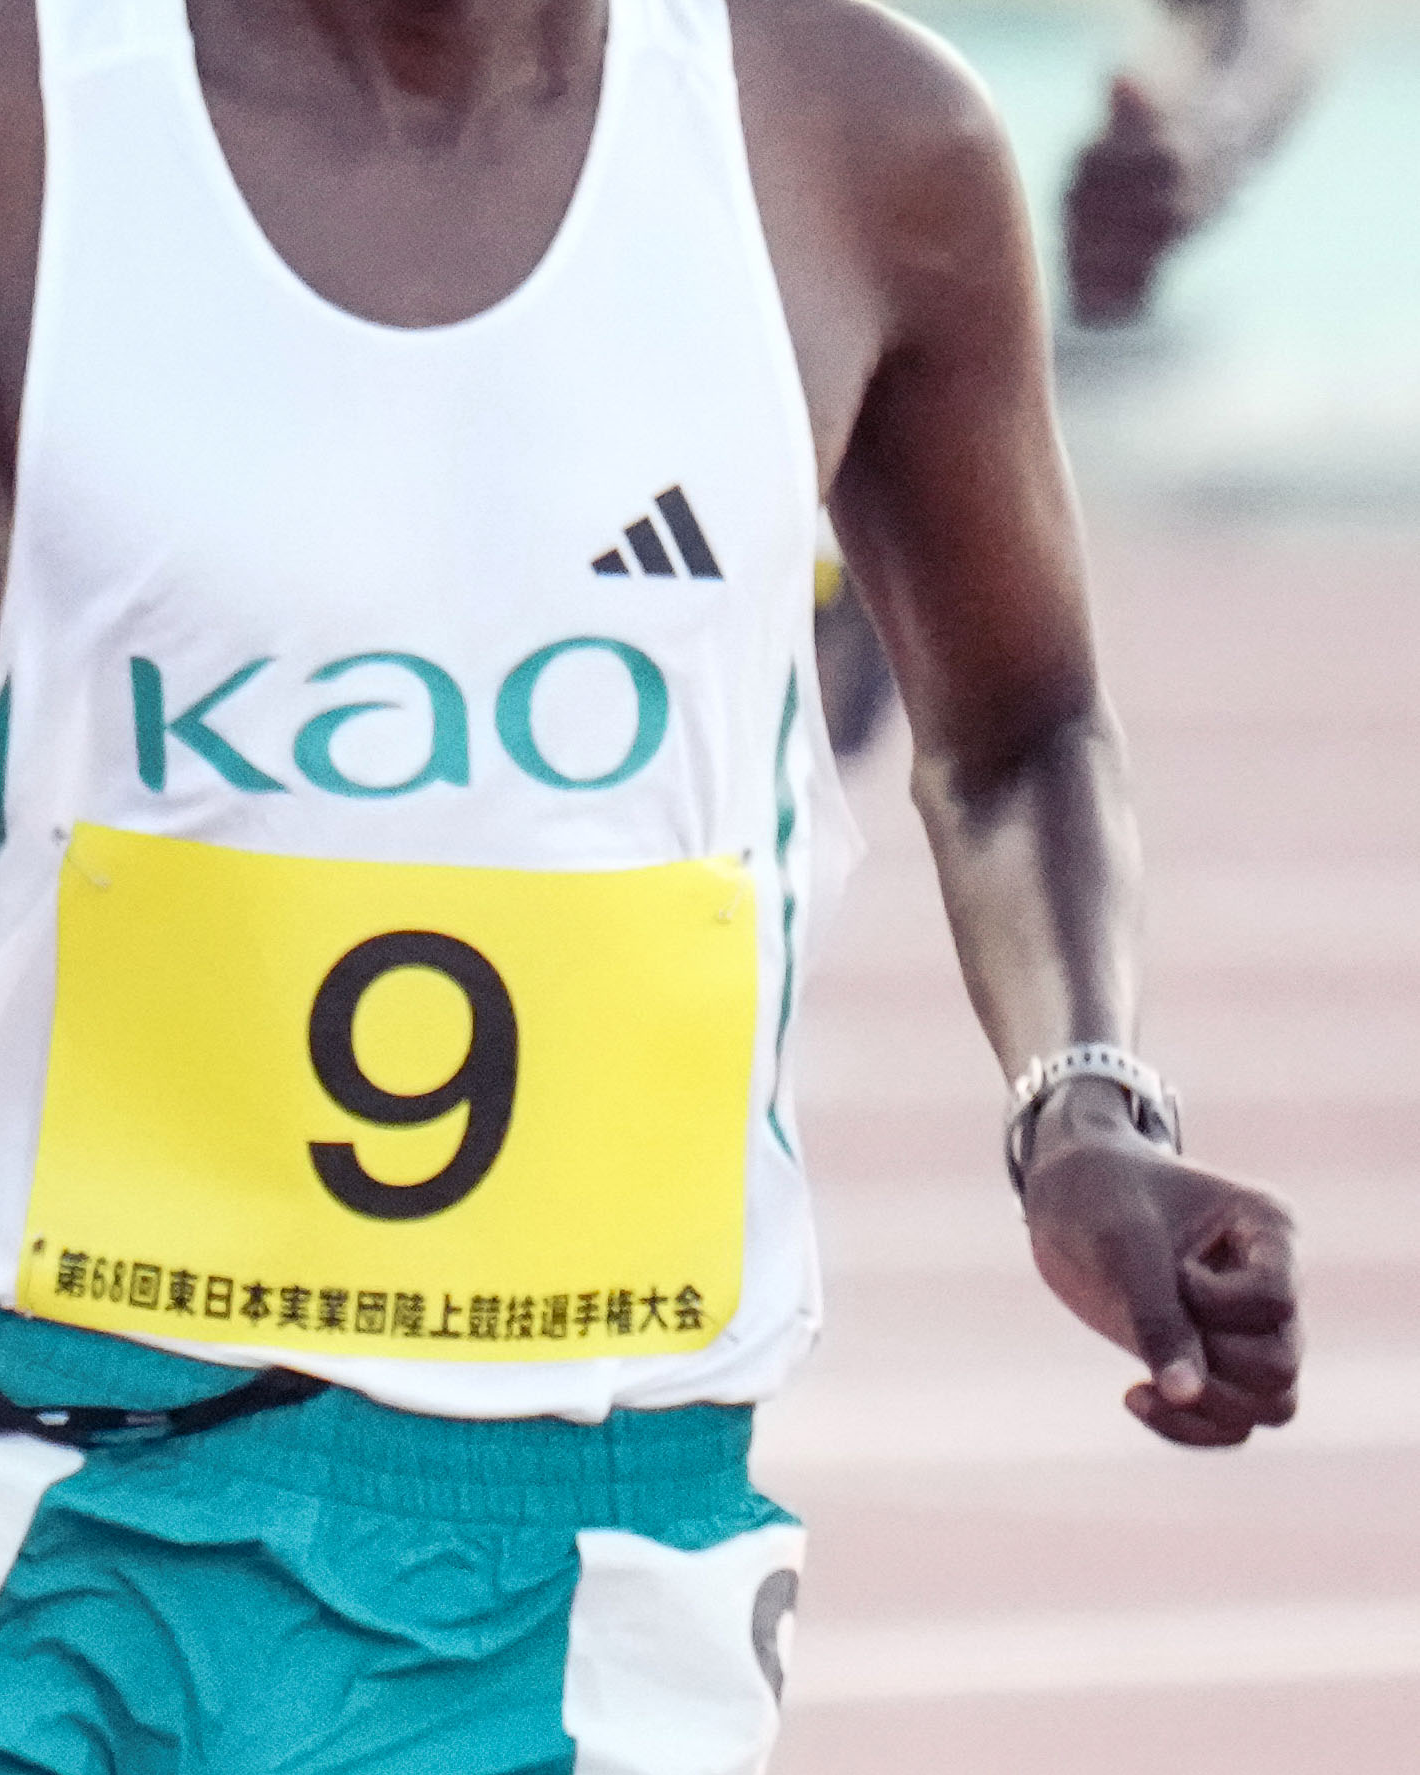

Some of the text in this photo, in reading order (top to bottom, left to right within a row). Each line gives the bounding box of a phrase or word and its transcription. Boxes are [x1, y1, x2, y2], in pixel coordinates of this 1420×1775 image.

[308, 930, 519, 1222] 9
[55, 1247, 704, 1341] 第68回東日本実業団陸上競技選手権大会
